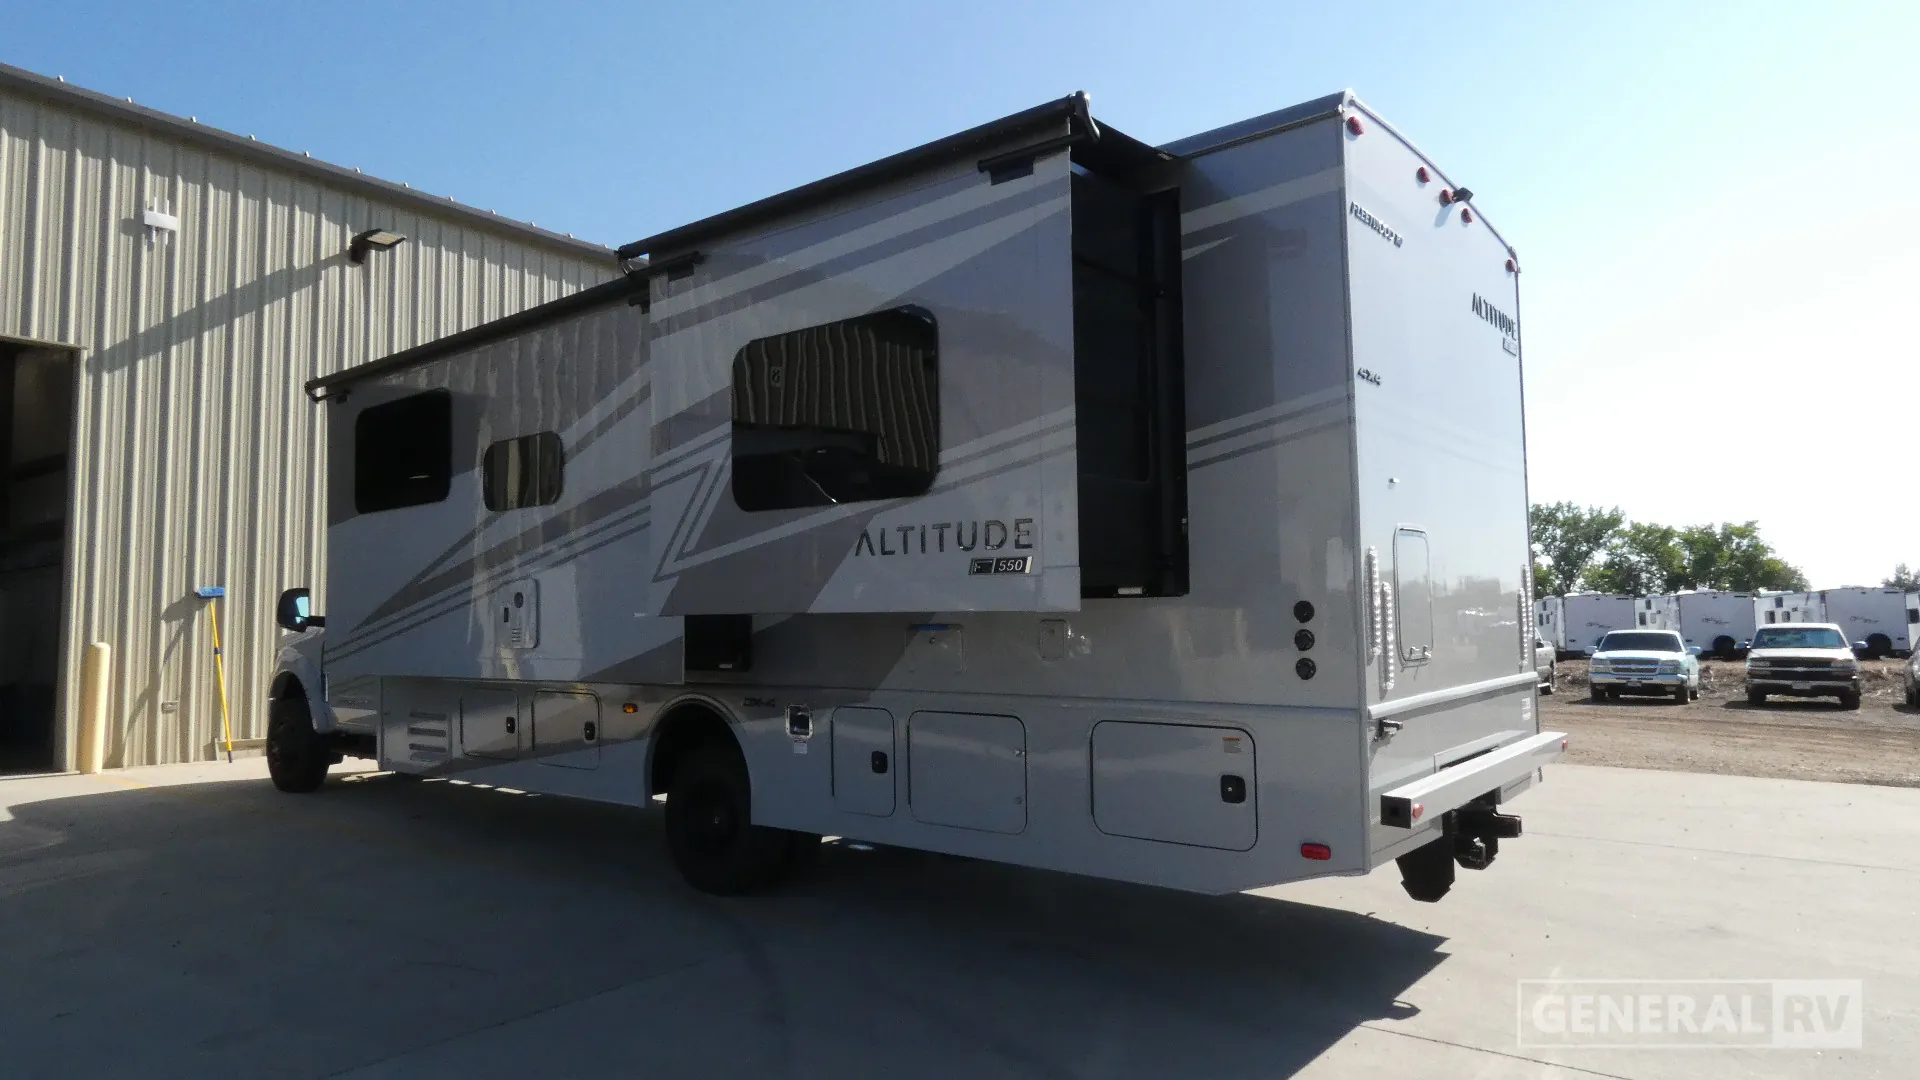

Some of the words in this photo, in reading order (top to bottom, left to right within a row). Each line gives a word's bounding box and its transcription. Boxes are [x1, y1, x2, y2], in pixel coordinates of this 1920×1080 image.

[1471, 292, 1517, 341] ALTITUDE
[854, 517, 1034, 557] ALTITUDE
[998, 559, 1023, 572] 550
